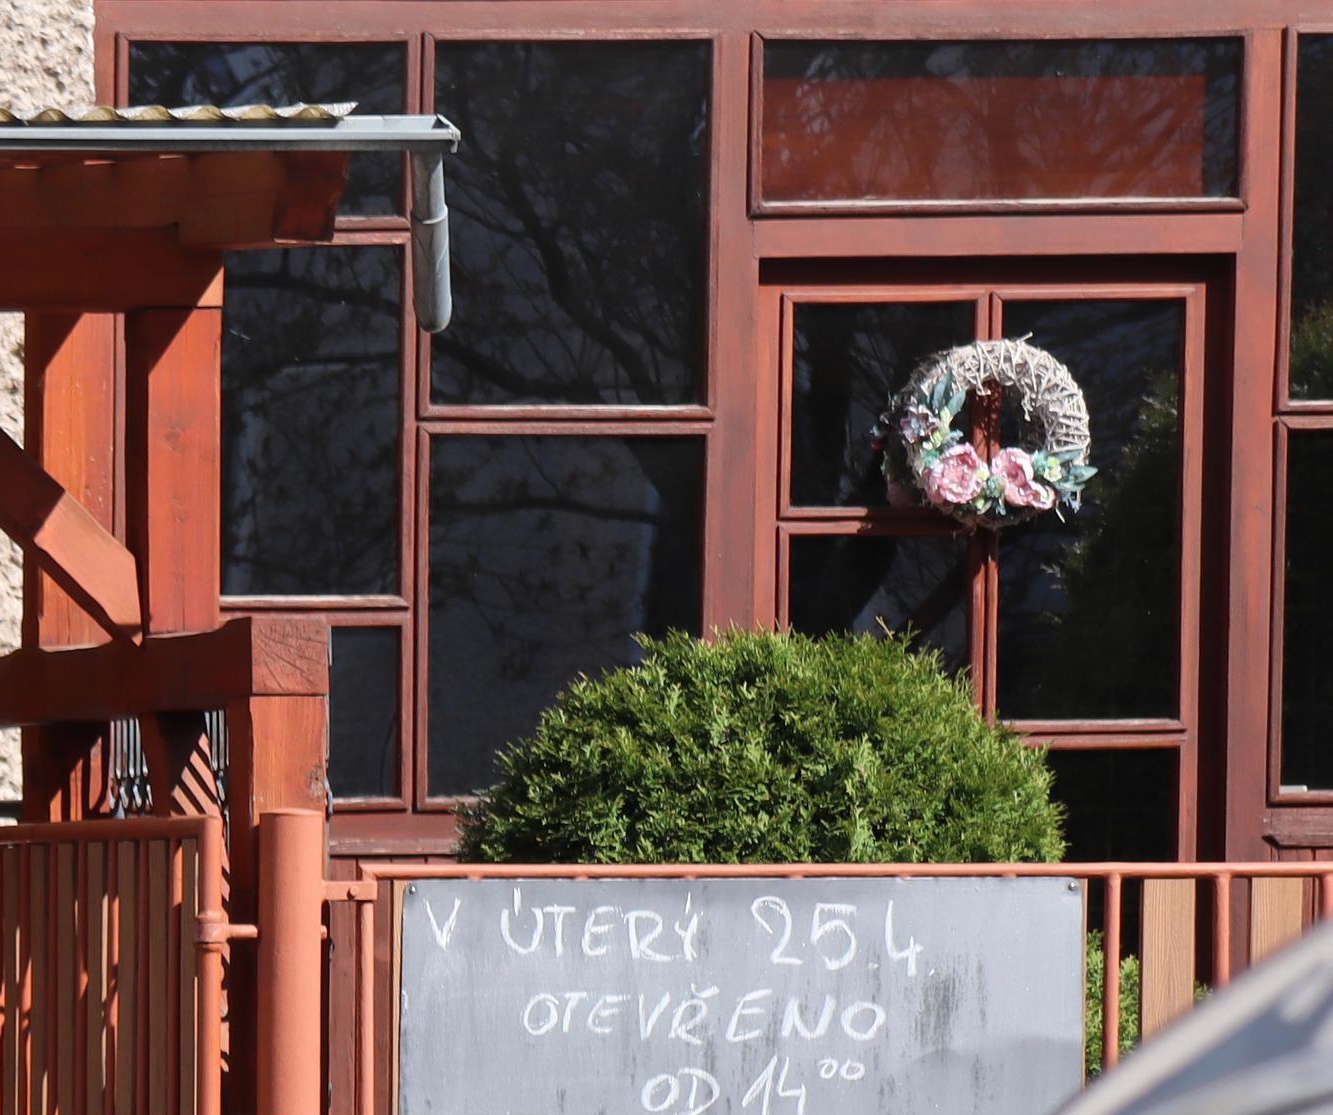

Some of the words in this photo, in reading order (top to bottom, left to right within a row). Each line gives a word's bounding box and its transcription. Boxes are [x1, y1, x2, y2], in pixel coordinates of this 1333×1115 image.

[424, 897, 461, 949] V
[500, 887, 699, 962] ÚTERÝ
[521, 982, 887, 1045] OTEVŘENO
